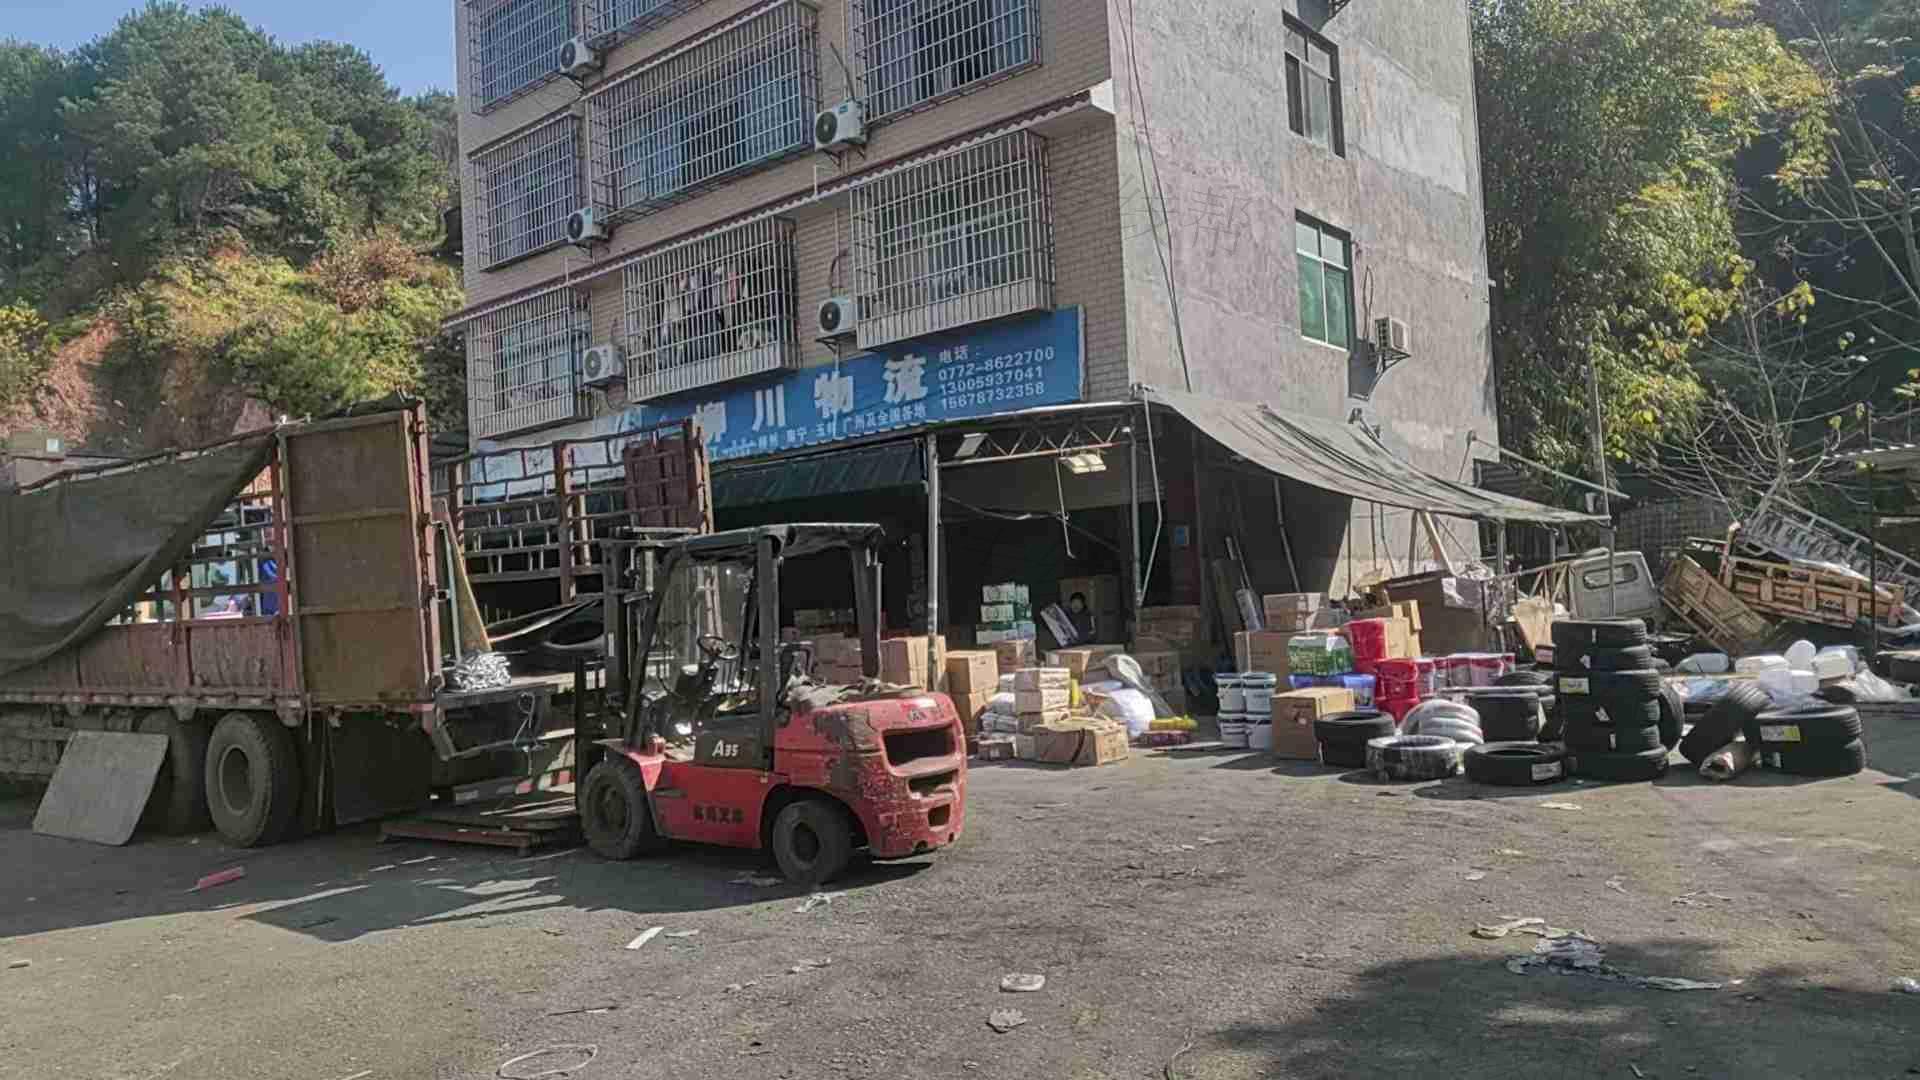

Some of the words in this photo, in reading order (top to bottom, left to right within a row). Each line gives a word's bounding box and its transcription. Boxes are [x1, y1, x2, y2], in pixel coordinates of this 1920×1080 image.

[938, 346, 1055, 381] 0772-8622700
[941, 366, 1043, 396] 13005937041
[711, 739, 739, 757] A35
